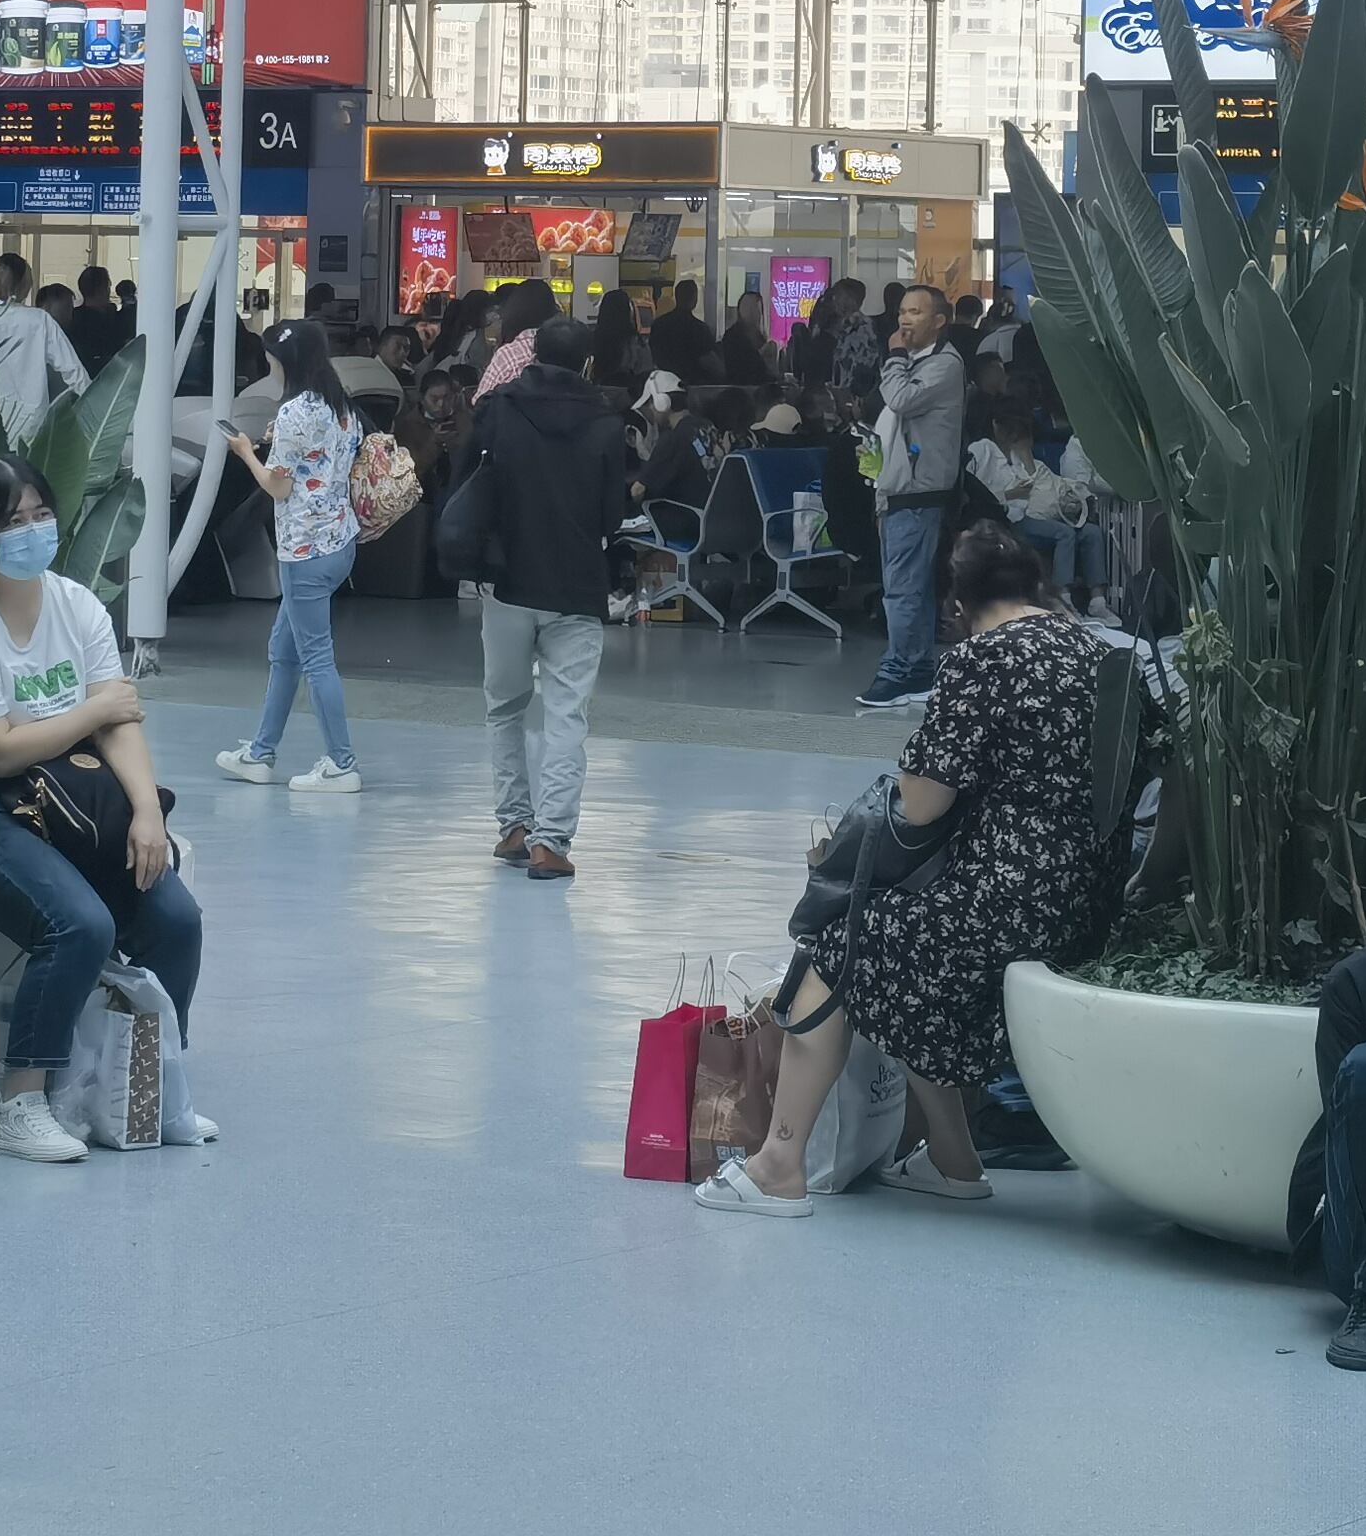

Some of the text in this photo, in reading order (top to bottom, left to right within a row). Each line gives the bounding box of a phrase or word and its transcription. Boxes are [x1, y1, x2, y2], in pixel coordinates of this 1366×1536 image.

[259, 112, 297, 149] 3A
[524, 144, 601, 166] 周黑鸭
[847, 151, 902, 175] 周黑鸭
